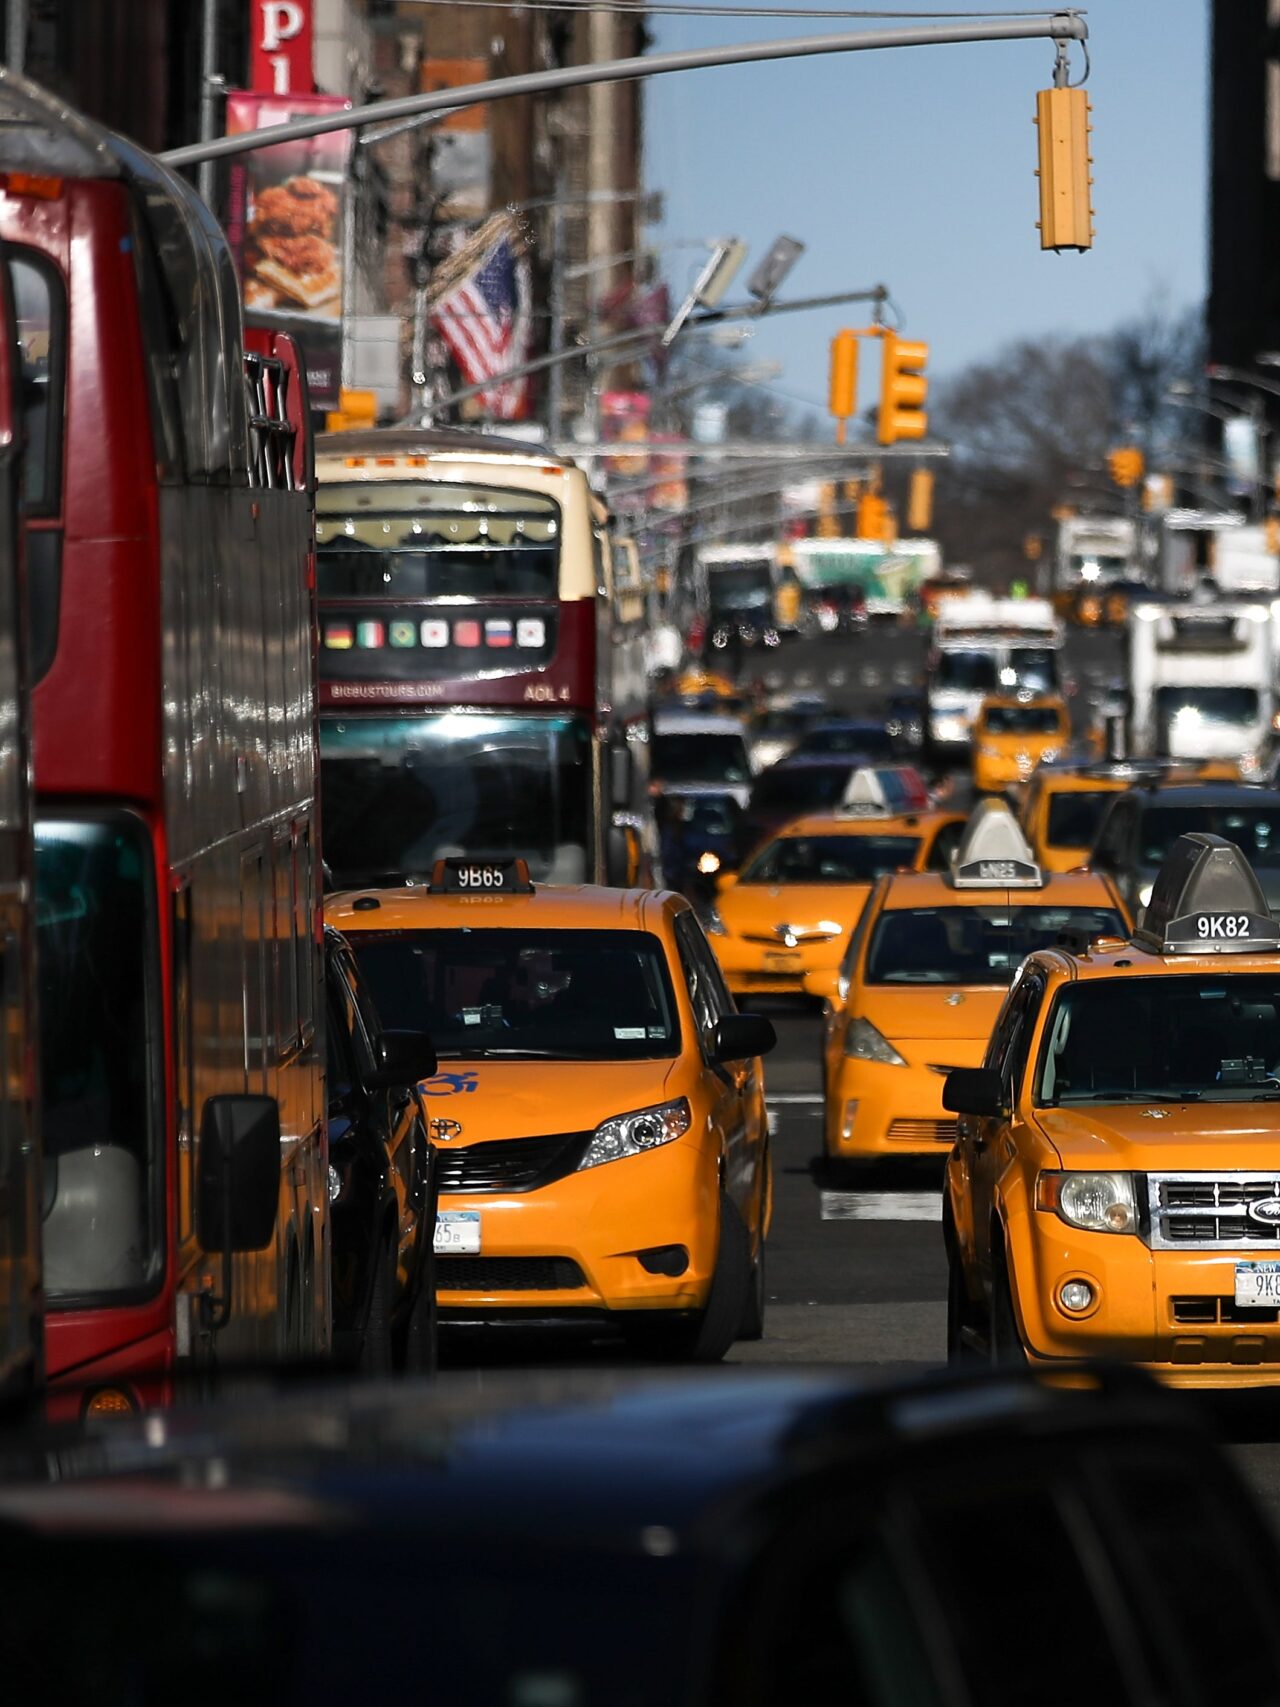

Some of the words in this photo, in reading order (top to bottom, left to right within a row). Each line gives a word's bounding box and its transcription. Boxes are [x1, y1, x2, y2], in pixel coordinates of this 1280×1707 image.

[458, 865, 504, 887] 9B65
[1197, 916, 1250, 938] 9K82
[1256, 1262, 1277, 1273] NEW
